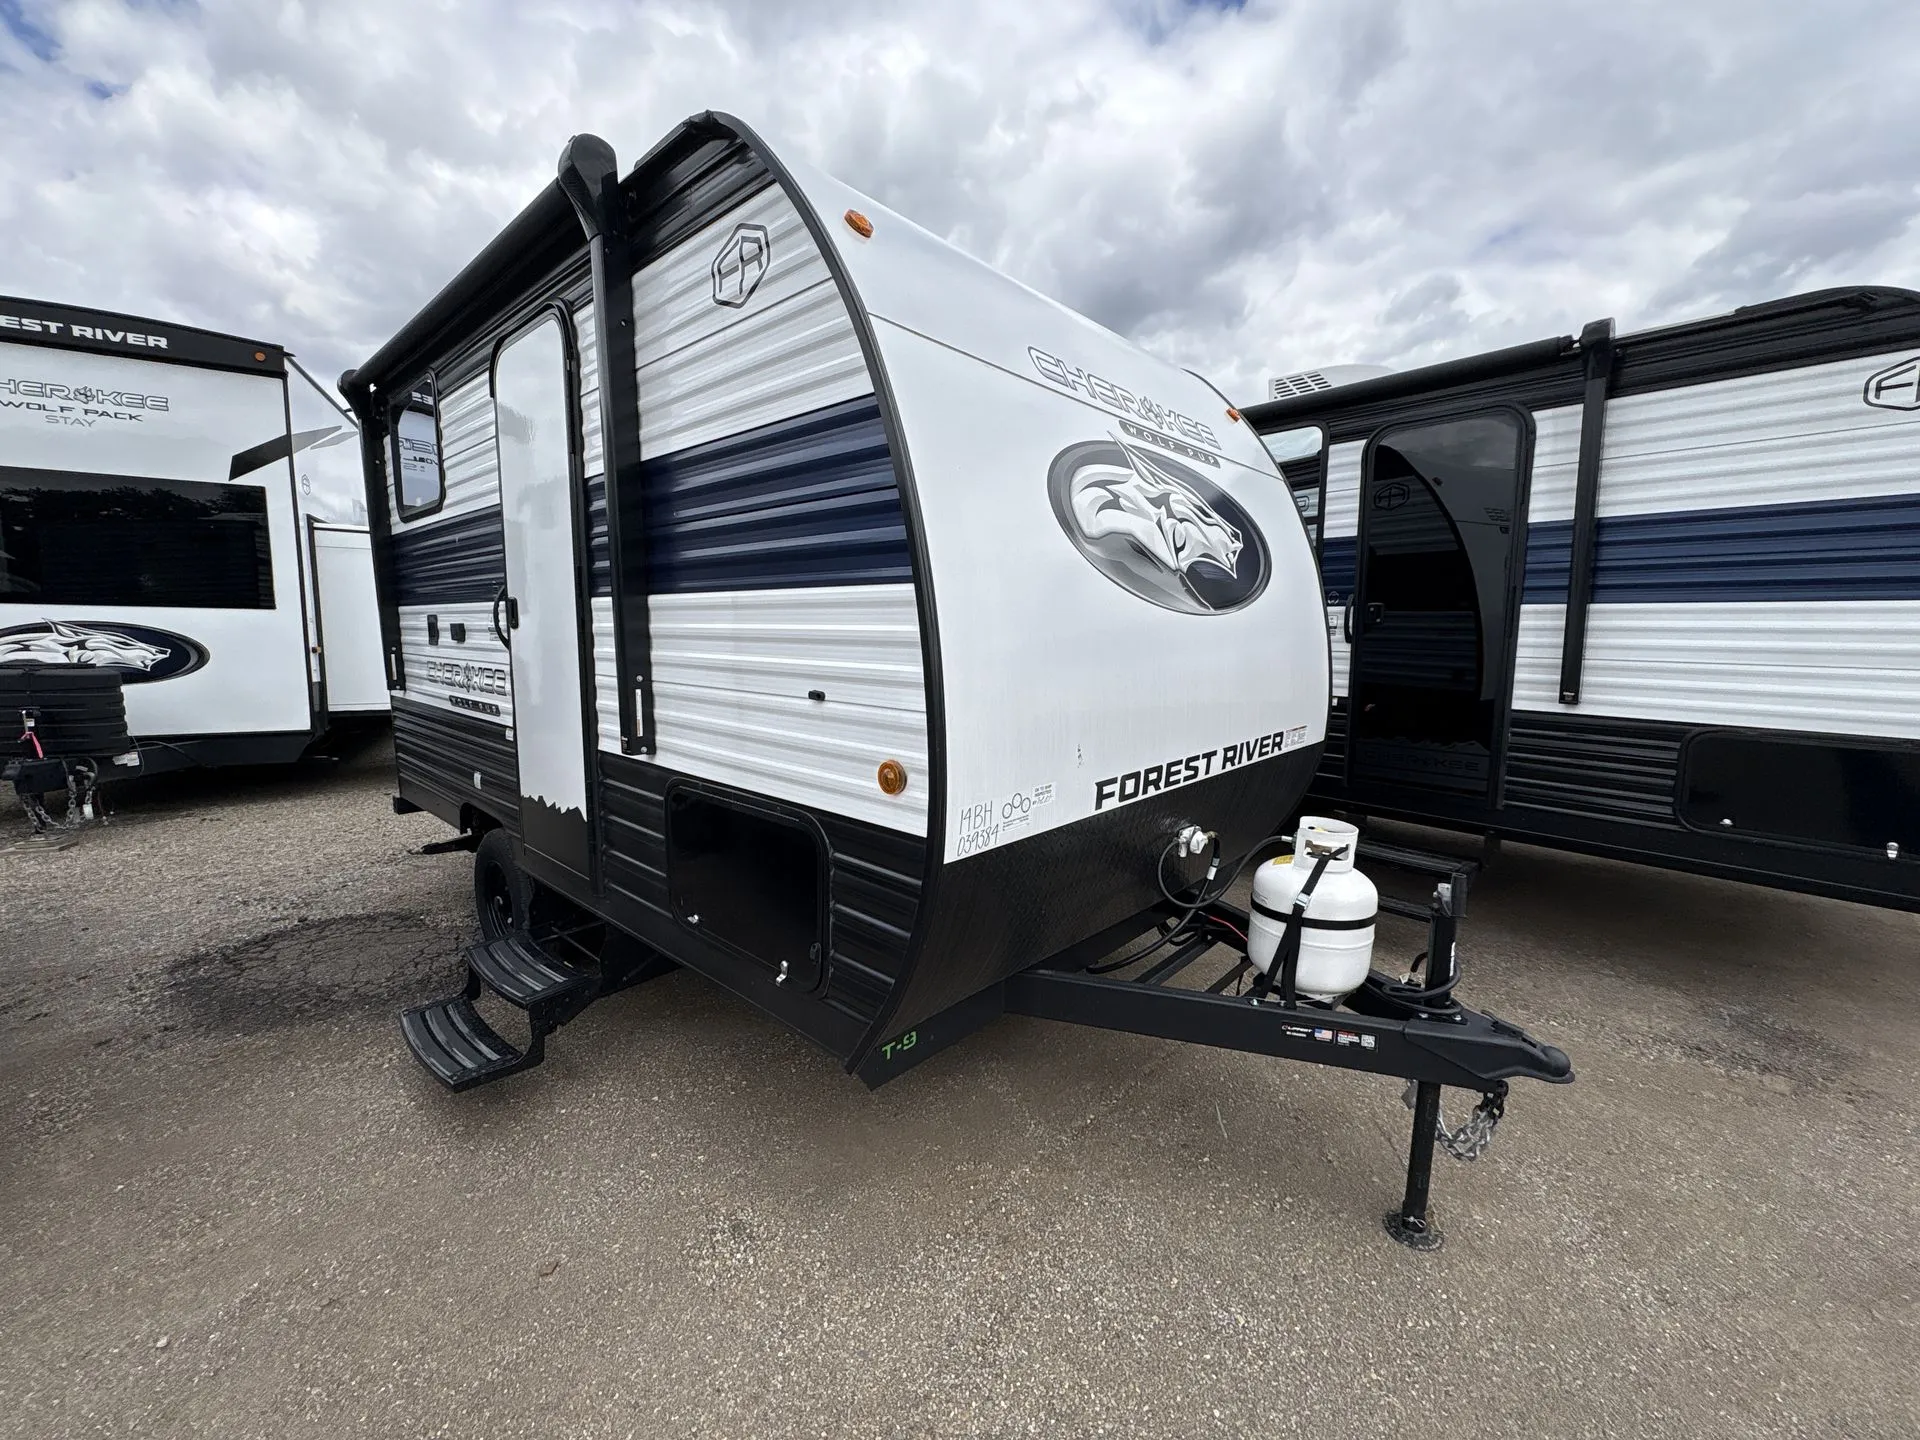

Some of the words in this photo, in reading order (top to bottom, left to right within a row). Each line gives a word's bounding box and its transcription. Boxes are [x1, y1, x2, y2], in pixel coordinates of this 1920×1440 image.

[70, 324, 168, 349] RIVER
[0, 400, 75, 413] WOLF
[82, 408, 143, 422] PACK
[45, 414, 97, 427] STAY
[1126, 424, 1175, 450] WOLF
[1187, 448, 1215, 464] PUP
[1095, 750, 1218, 811] FOREST
[1221, 731, 1285, 771] RIVER
[960, 800, 993, 835] 14BH
[957, 823, 1000, 857] 039384
